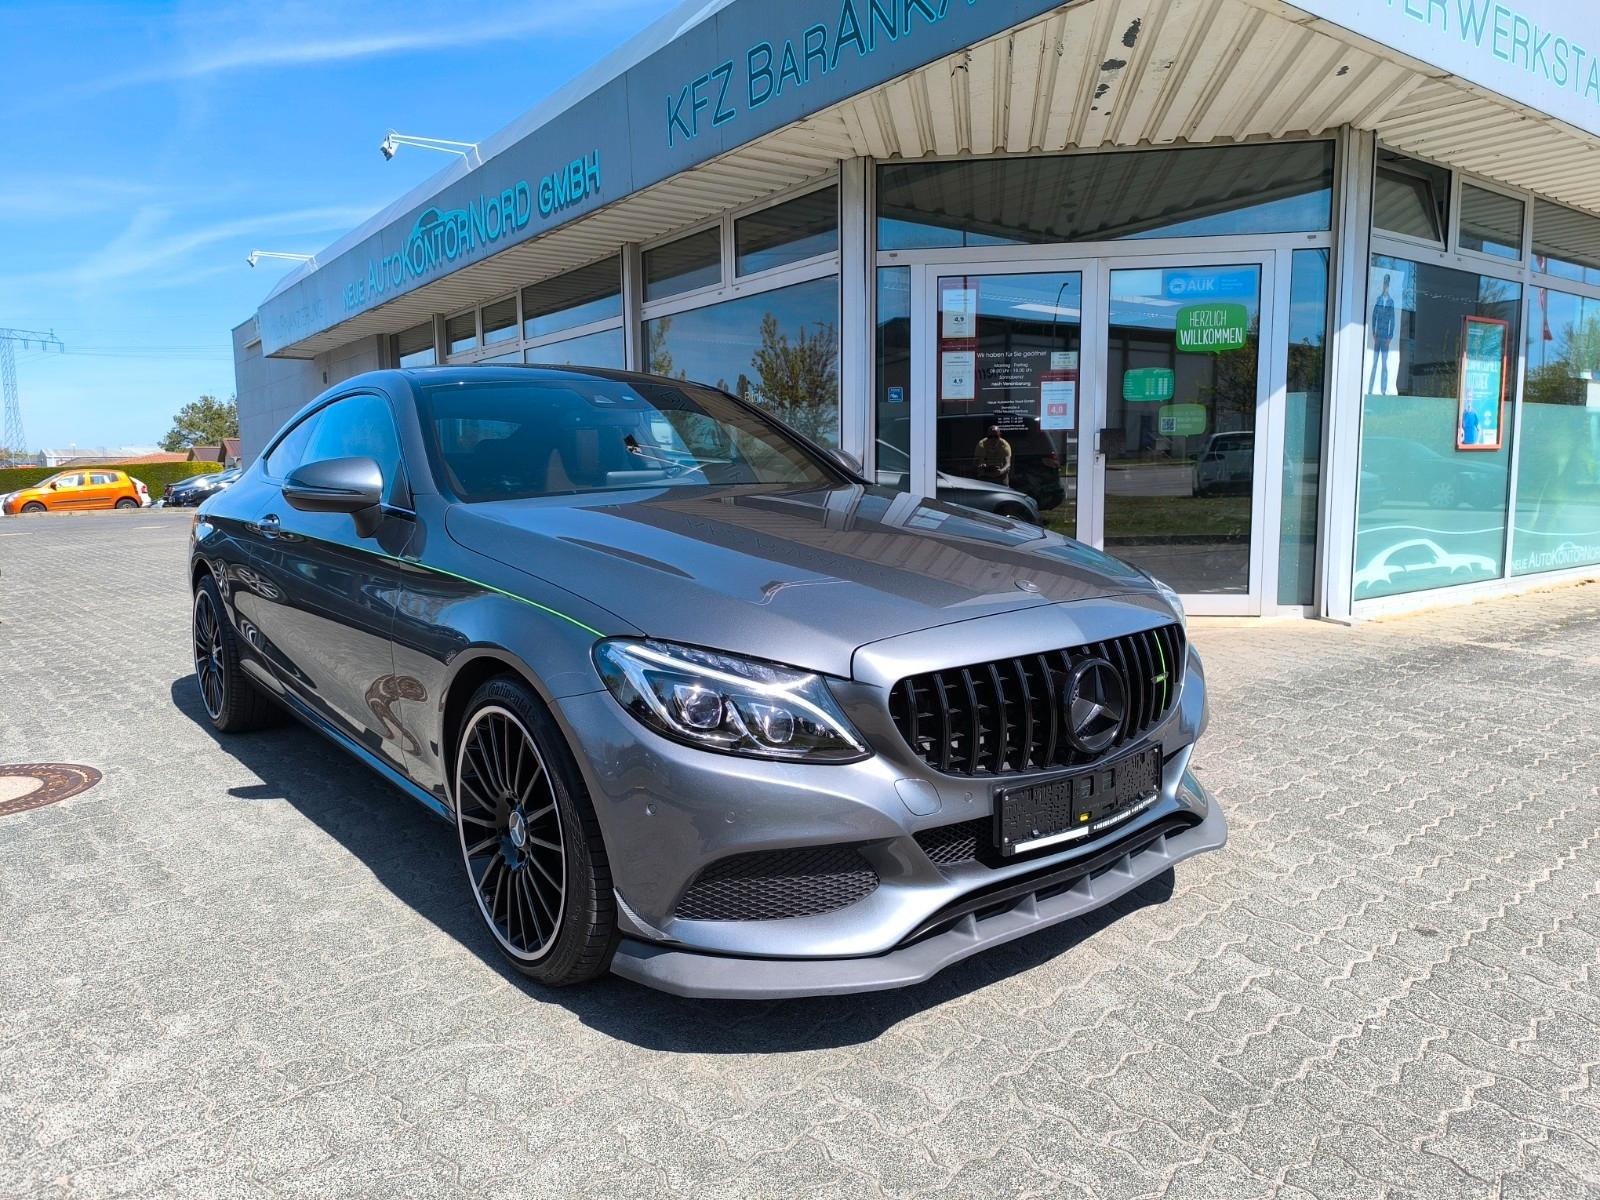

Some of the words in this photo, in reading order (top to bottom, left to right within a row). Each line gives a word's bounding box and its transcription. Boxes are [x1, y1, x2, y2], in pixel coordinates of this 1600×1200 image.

[666, 59, 737, 148] KFZ
[1189, 309, 1227, 327] HERZLICH
[1180, 327, 1243, 346] WILLKOMMEN
